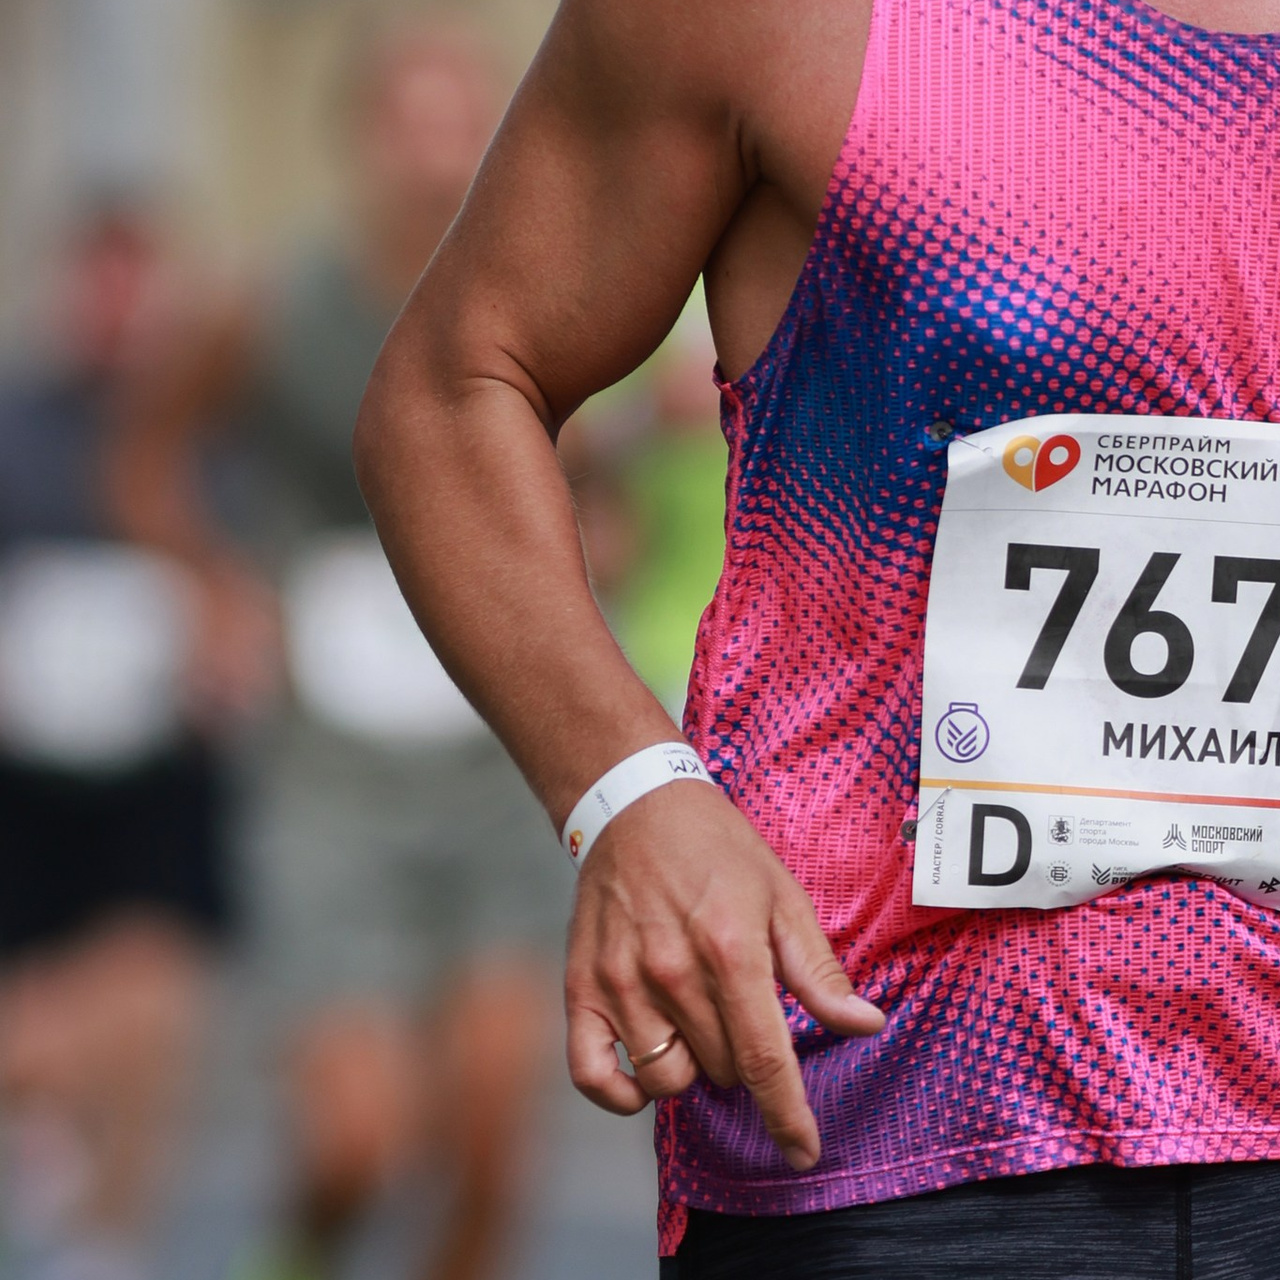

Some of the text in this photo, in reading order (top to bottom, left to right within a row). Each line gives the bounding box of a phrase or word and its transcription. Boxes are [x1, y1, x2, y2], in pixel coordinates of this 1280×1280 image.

[1097, 434, 1231, 454] СБЕРПРАЙМ
[1093, 454, 1279, 482] МОСКОВСКИЙ
[1091, 477, 1228, 503] МАРАФОН
[935, 799, 946, 835] CORRAL
[967, 803, 1033, 887] D
[1191, 825, 1263, 843] МОСКОВСКИЙ
[1191, 840, 1225, 855] СПОРТ
[932, 842, 943, 885] КЛАСТЕР
